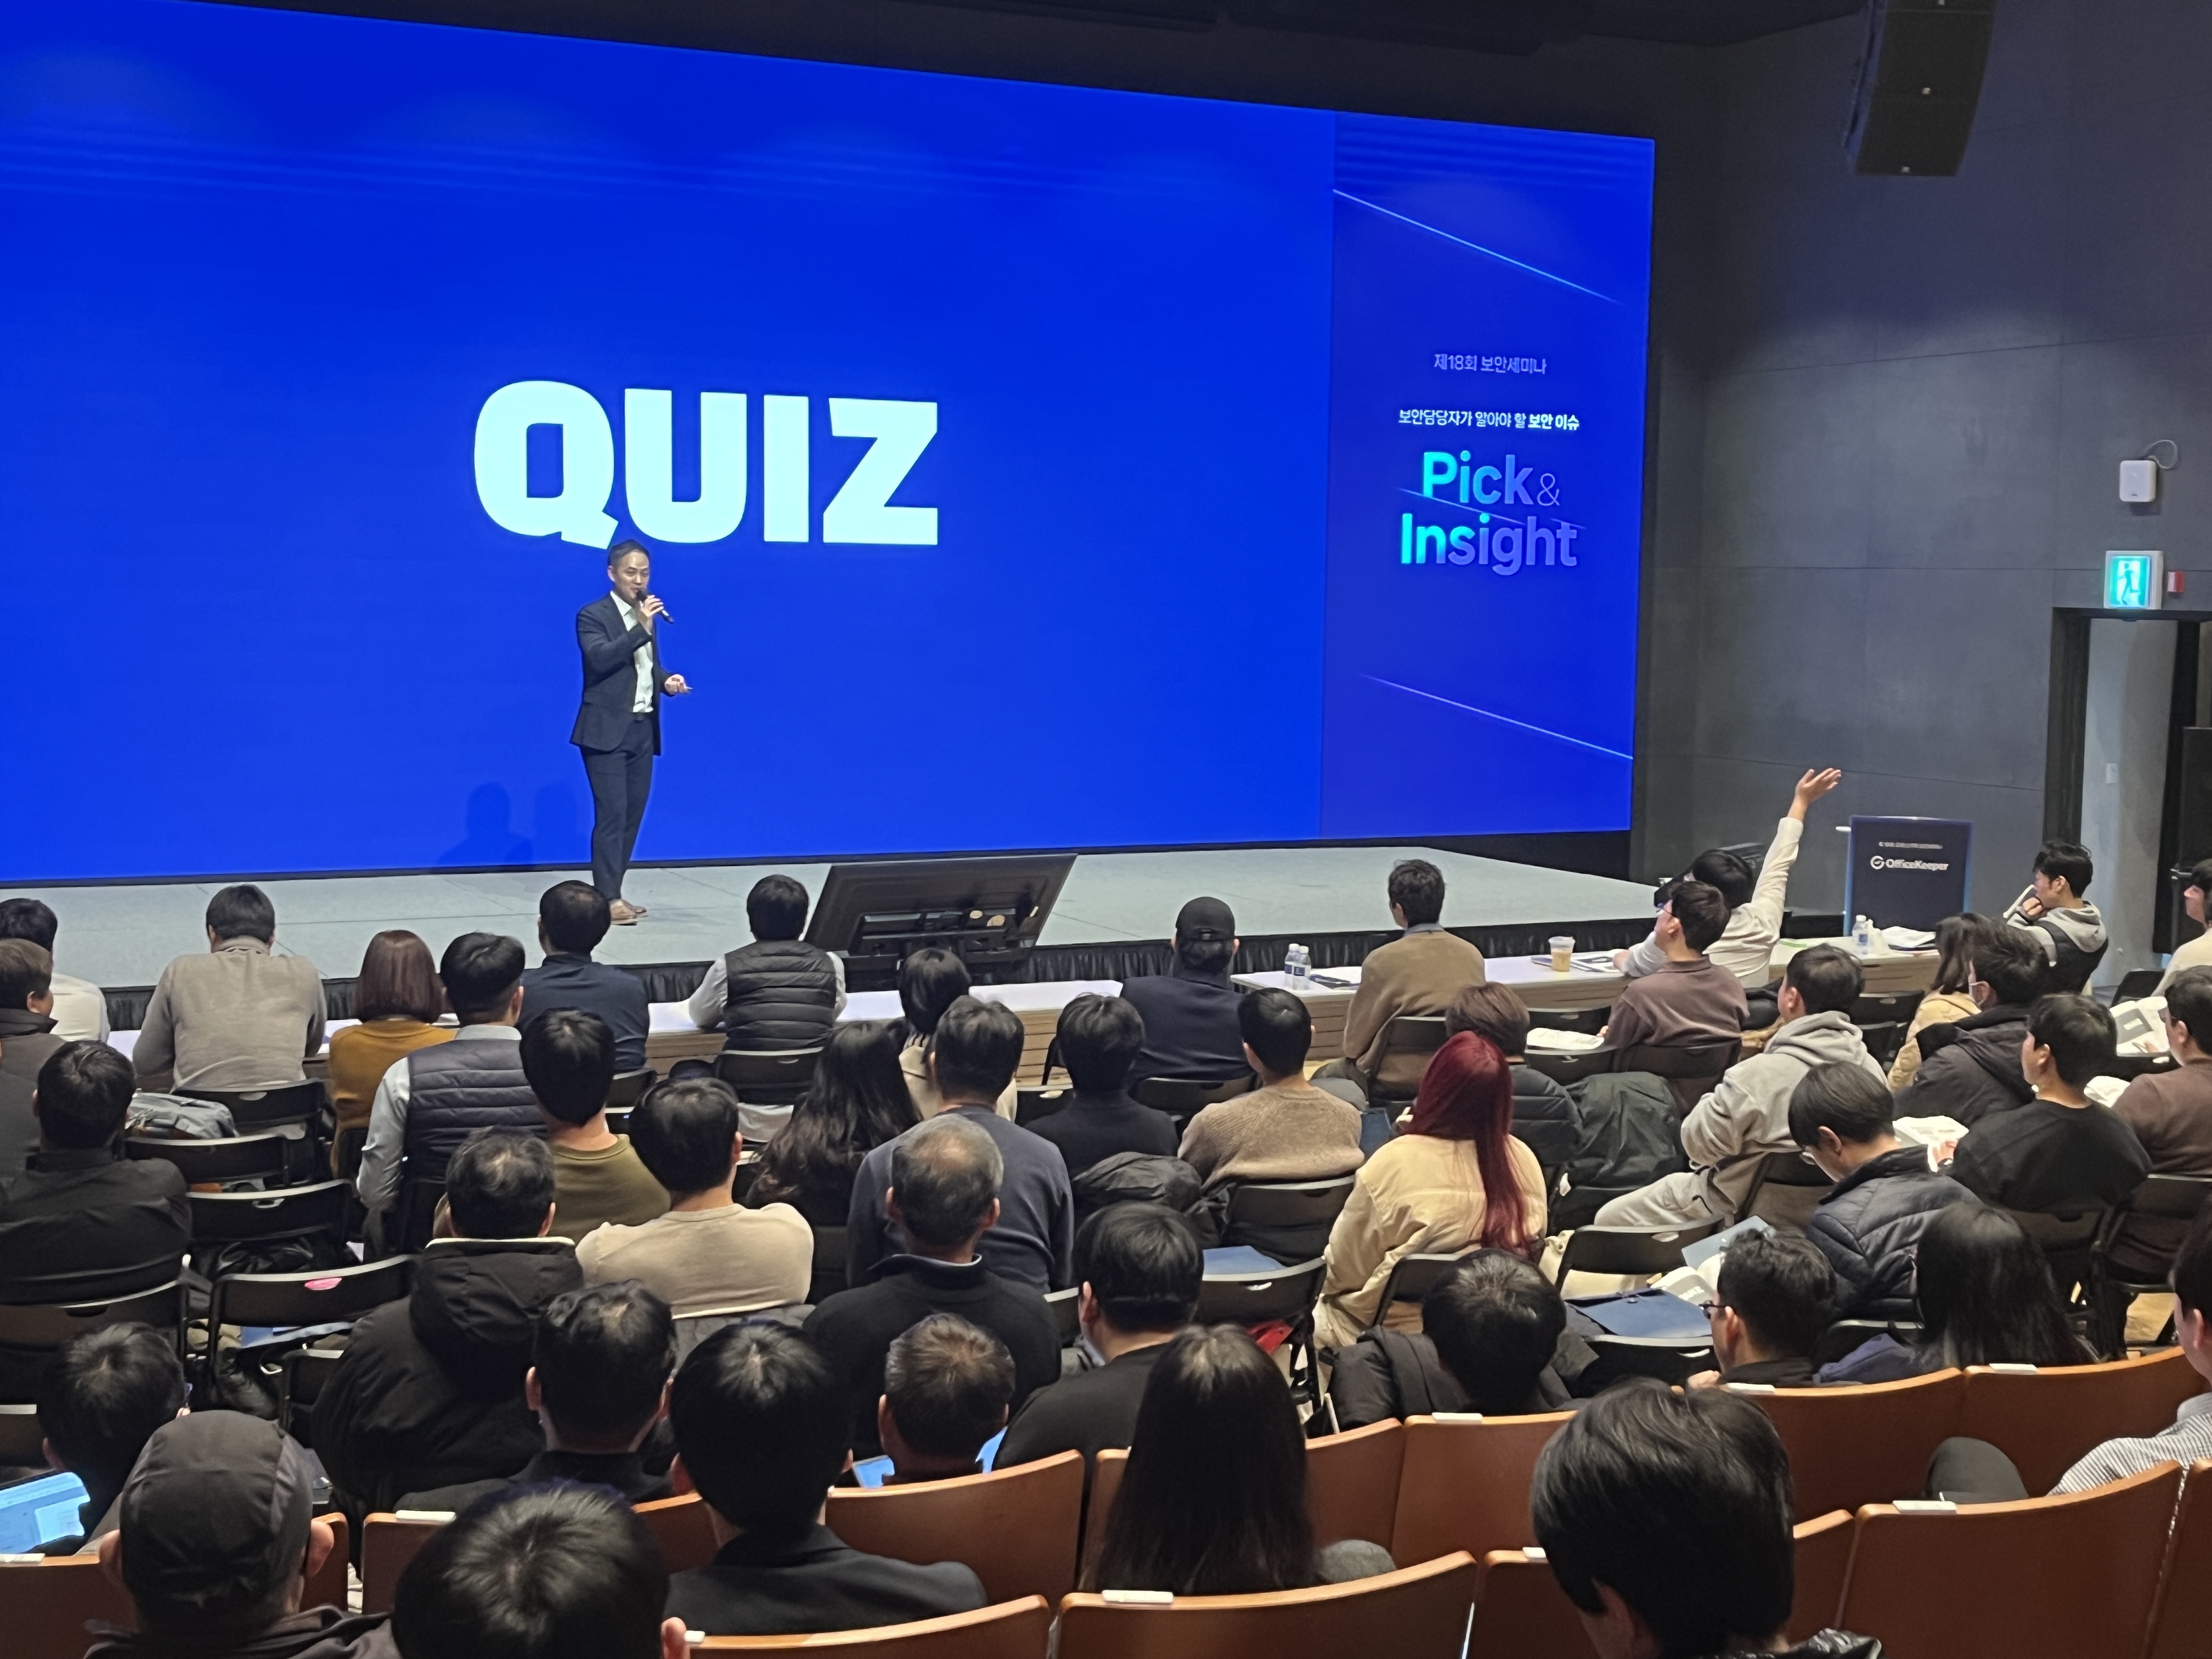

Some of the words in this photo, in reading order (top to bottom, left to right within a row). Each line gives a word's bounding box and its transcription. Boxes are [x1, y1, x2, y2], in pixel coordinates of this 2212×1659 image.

[1434, 353, 1477, 371] 제18회
[1480, 356, 1547, 374] 보안세미나
[1398, 409, 1473, 426] 보안담당자가
[1475, 411, 1512, 428] 알아야
[1514, 413, 1527, 429] 할
[1527, 413, 1554, 430] 보안
[1555, 414, 1580, 431] 이슈
[473, 380, 939, 550] QUIZ
[1401, 512, 1578, 575] Insight
